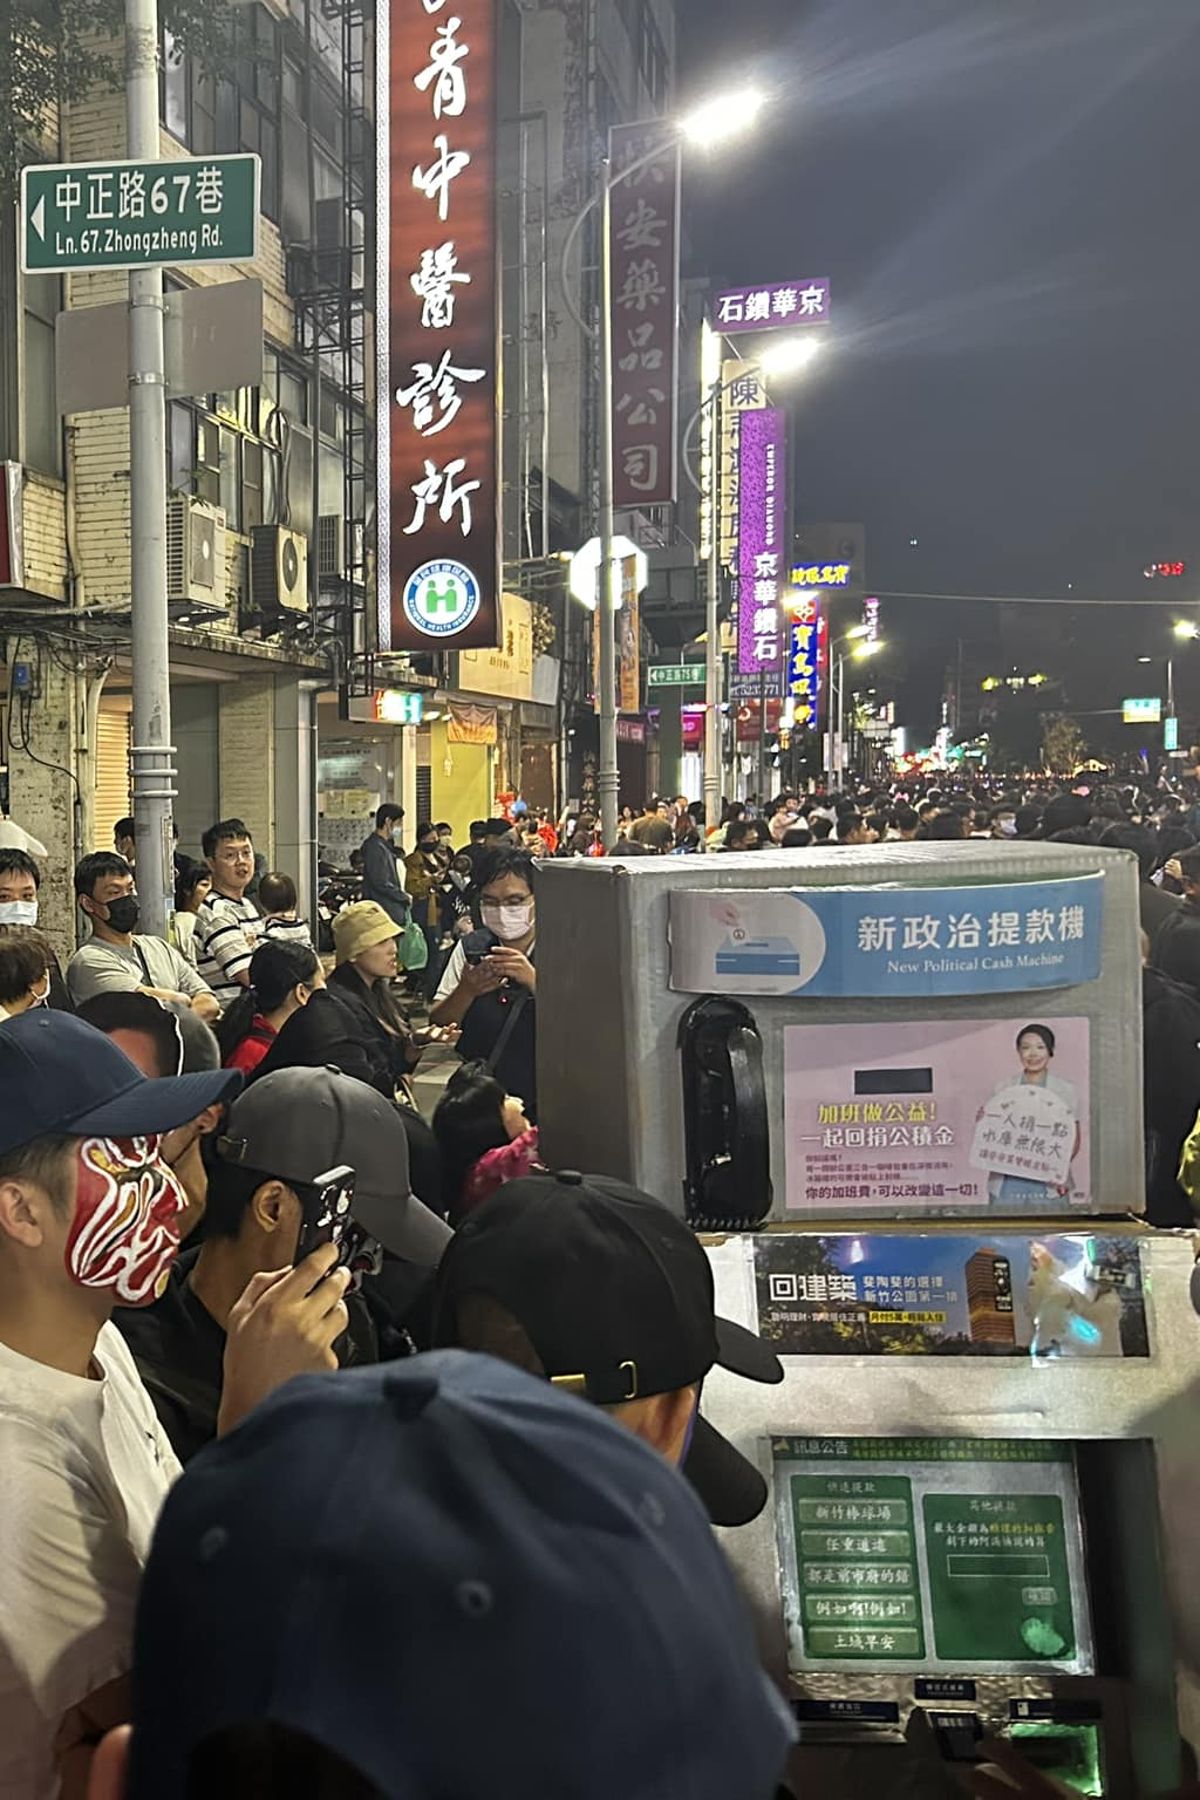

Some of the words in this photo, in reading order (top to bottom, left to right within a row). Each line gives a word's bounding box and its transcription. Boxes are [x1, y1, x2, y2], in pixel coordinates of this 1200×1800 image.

[56, 166, 224, 222] 中正路67巷
[104, 225, 198, 257] Zhongzheng
[201, 223, 224, 248] Rd.
[395, 0, 488, 538] 青中醫診所
[752, 551, 779, 661] 京華鑽石
[857, 905, 1085, 951] 新政治提款機
[887, 960, 919, 974] New
[924, 958, 978, 973] Political
[981, 955, 1014, 971] Cash
[1017, 951, 1066, 968] Machine
[818, 1102, 938, 1124] 加班做公益！
[800, 1125, 955, 1148] 一起回捐公積金
[815, 1504, 892, 1521] 新竹棒球場
[833, 1633, 897, 1651] 土城早安
